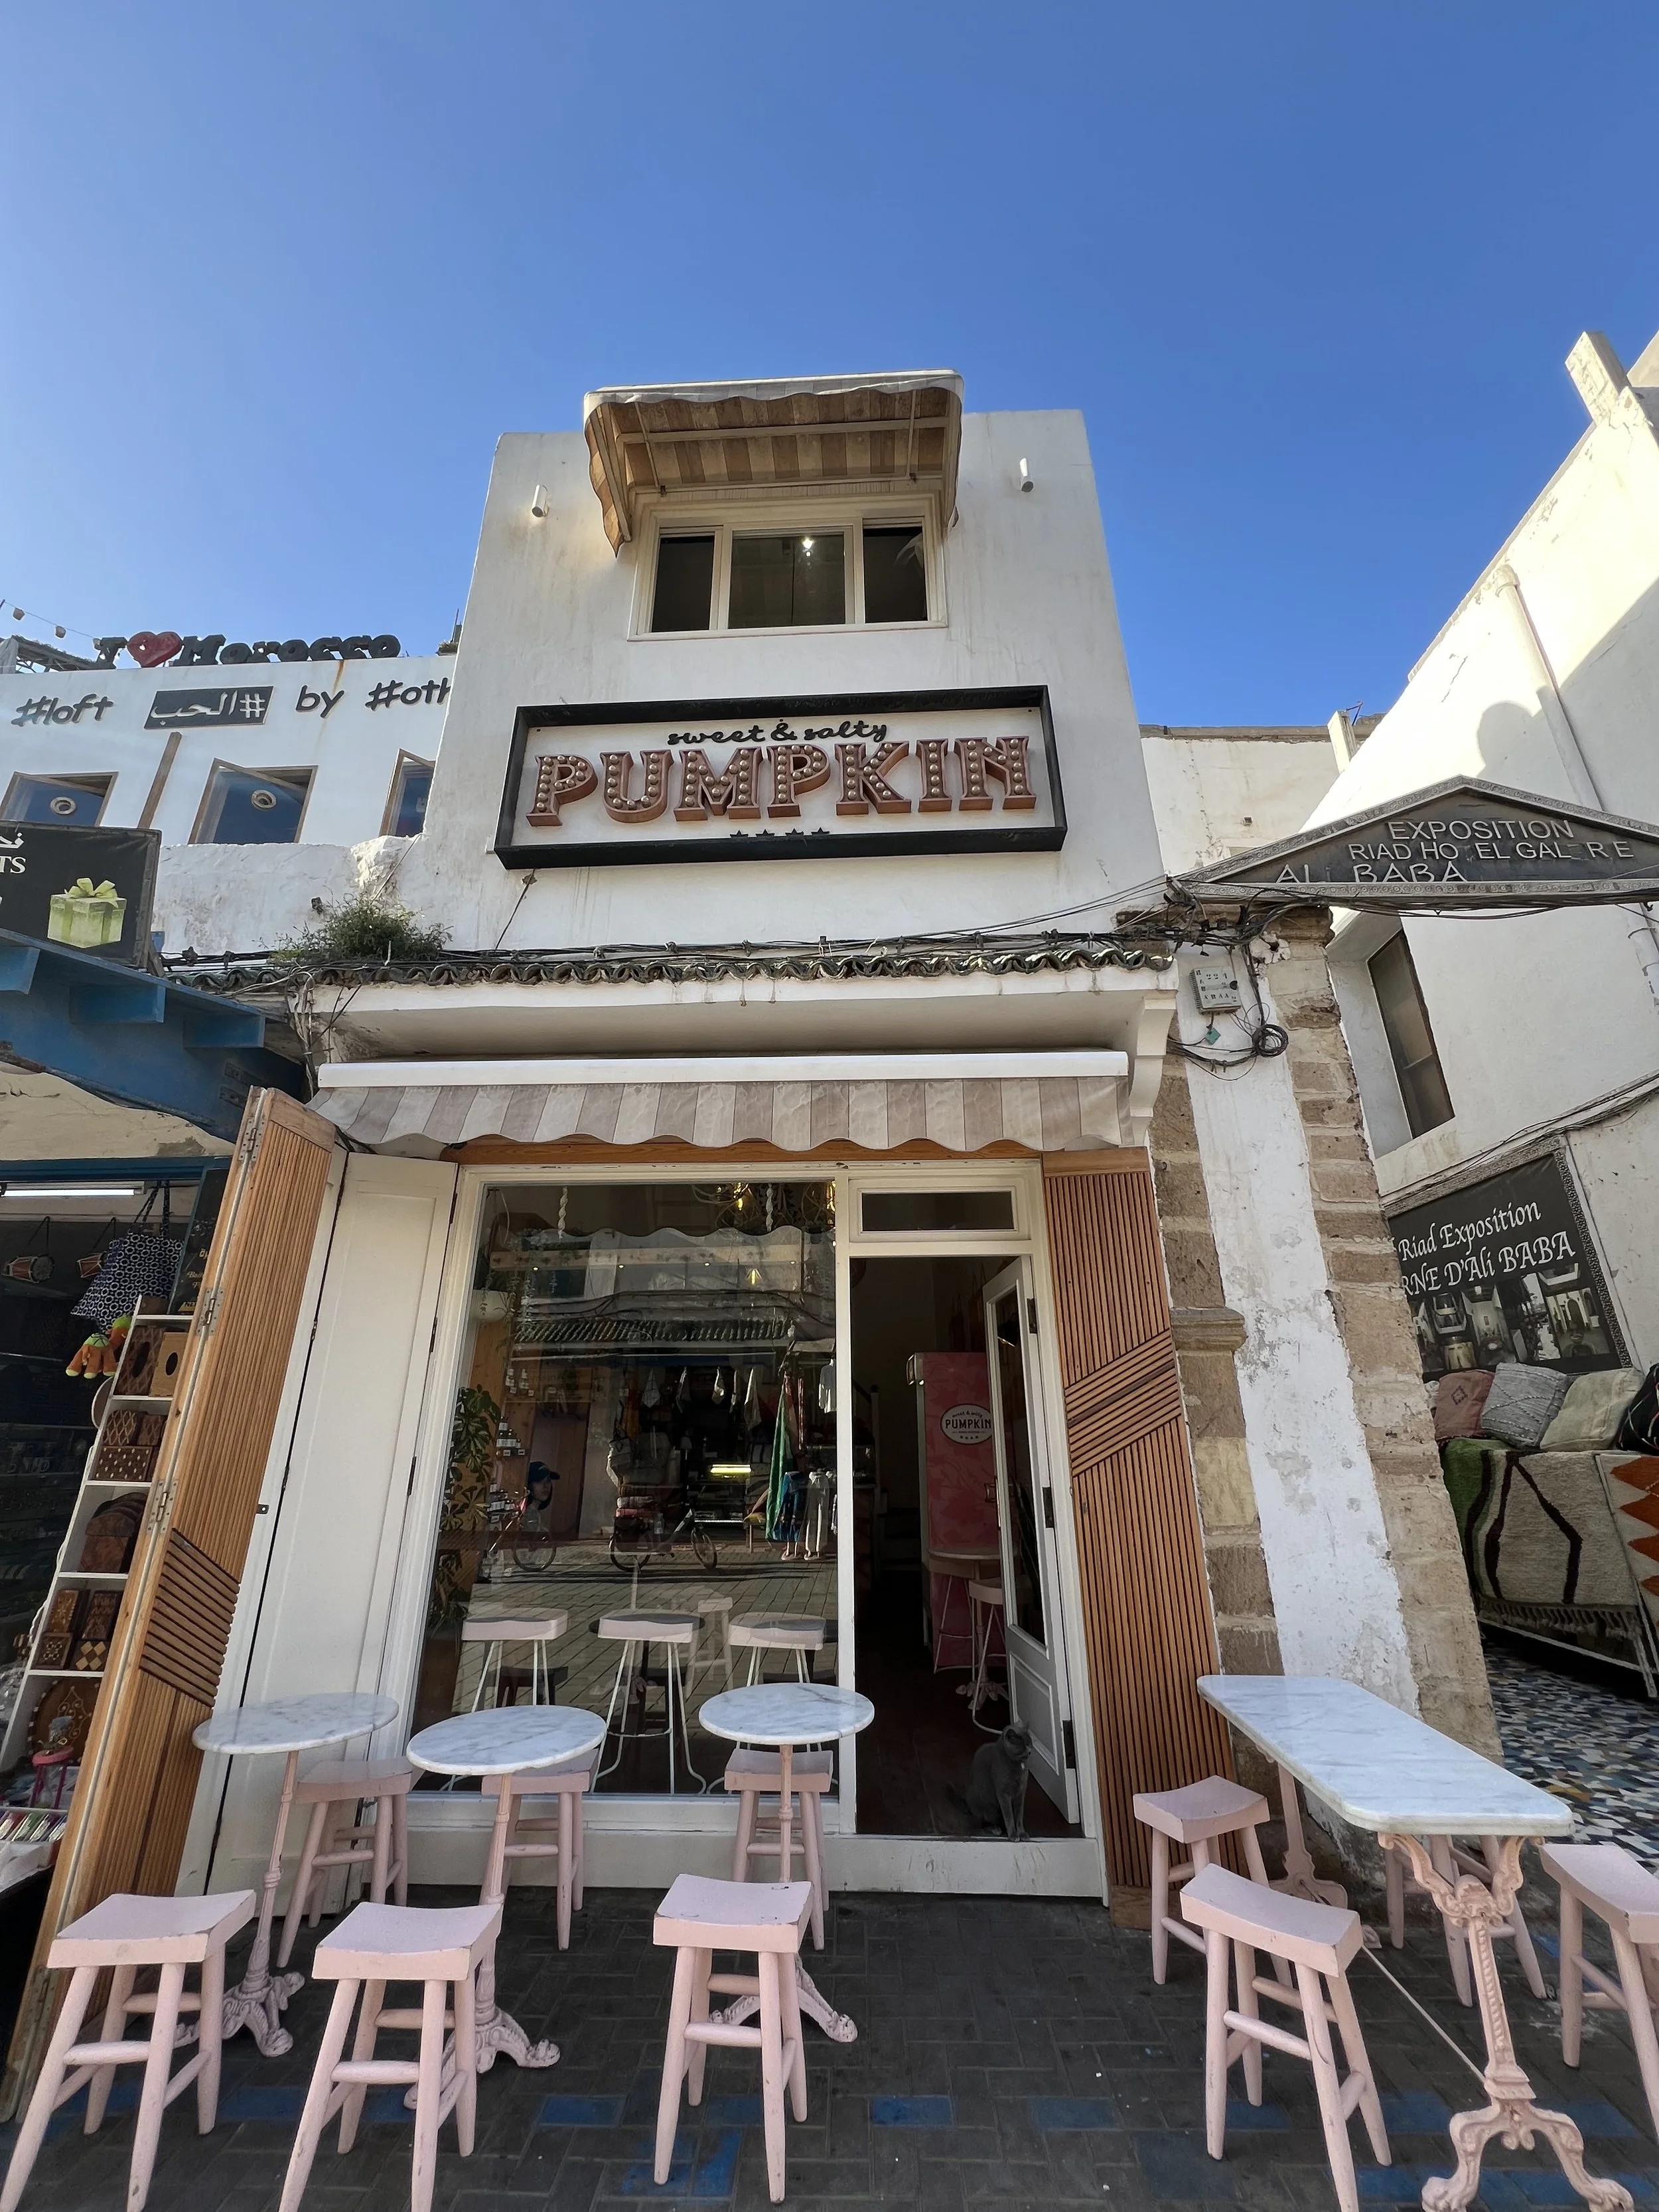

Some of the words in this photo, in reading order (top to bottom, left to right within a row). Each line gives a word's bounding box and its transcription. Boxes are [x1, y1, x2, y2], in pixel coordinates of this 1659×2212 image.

[167, 634, 401, 666] Morocco
[11, 694, 113, 727] #loft
[295, 685, 344, 717] by
[667, 725, 765, 745] sweet
[770, 722, 797, 741] &
[804, 720, 887, 743] salty
[526, 735, 1036, 827] PUMPKIN
[1388, 820, 1574, 840] EXPOSITION
[1348, 842, 1411, 861] RIAD
[1353, 861, 1468, 883] BABA
[1398, 1222, 1437, 1261] Riad
[1440, 1201, 1542, 1254] Exposition
[1499, 1230, 1576, 1273] BABA
[945, 1419, 991, 1429] PUMPKIN
